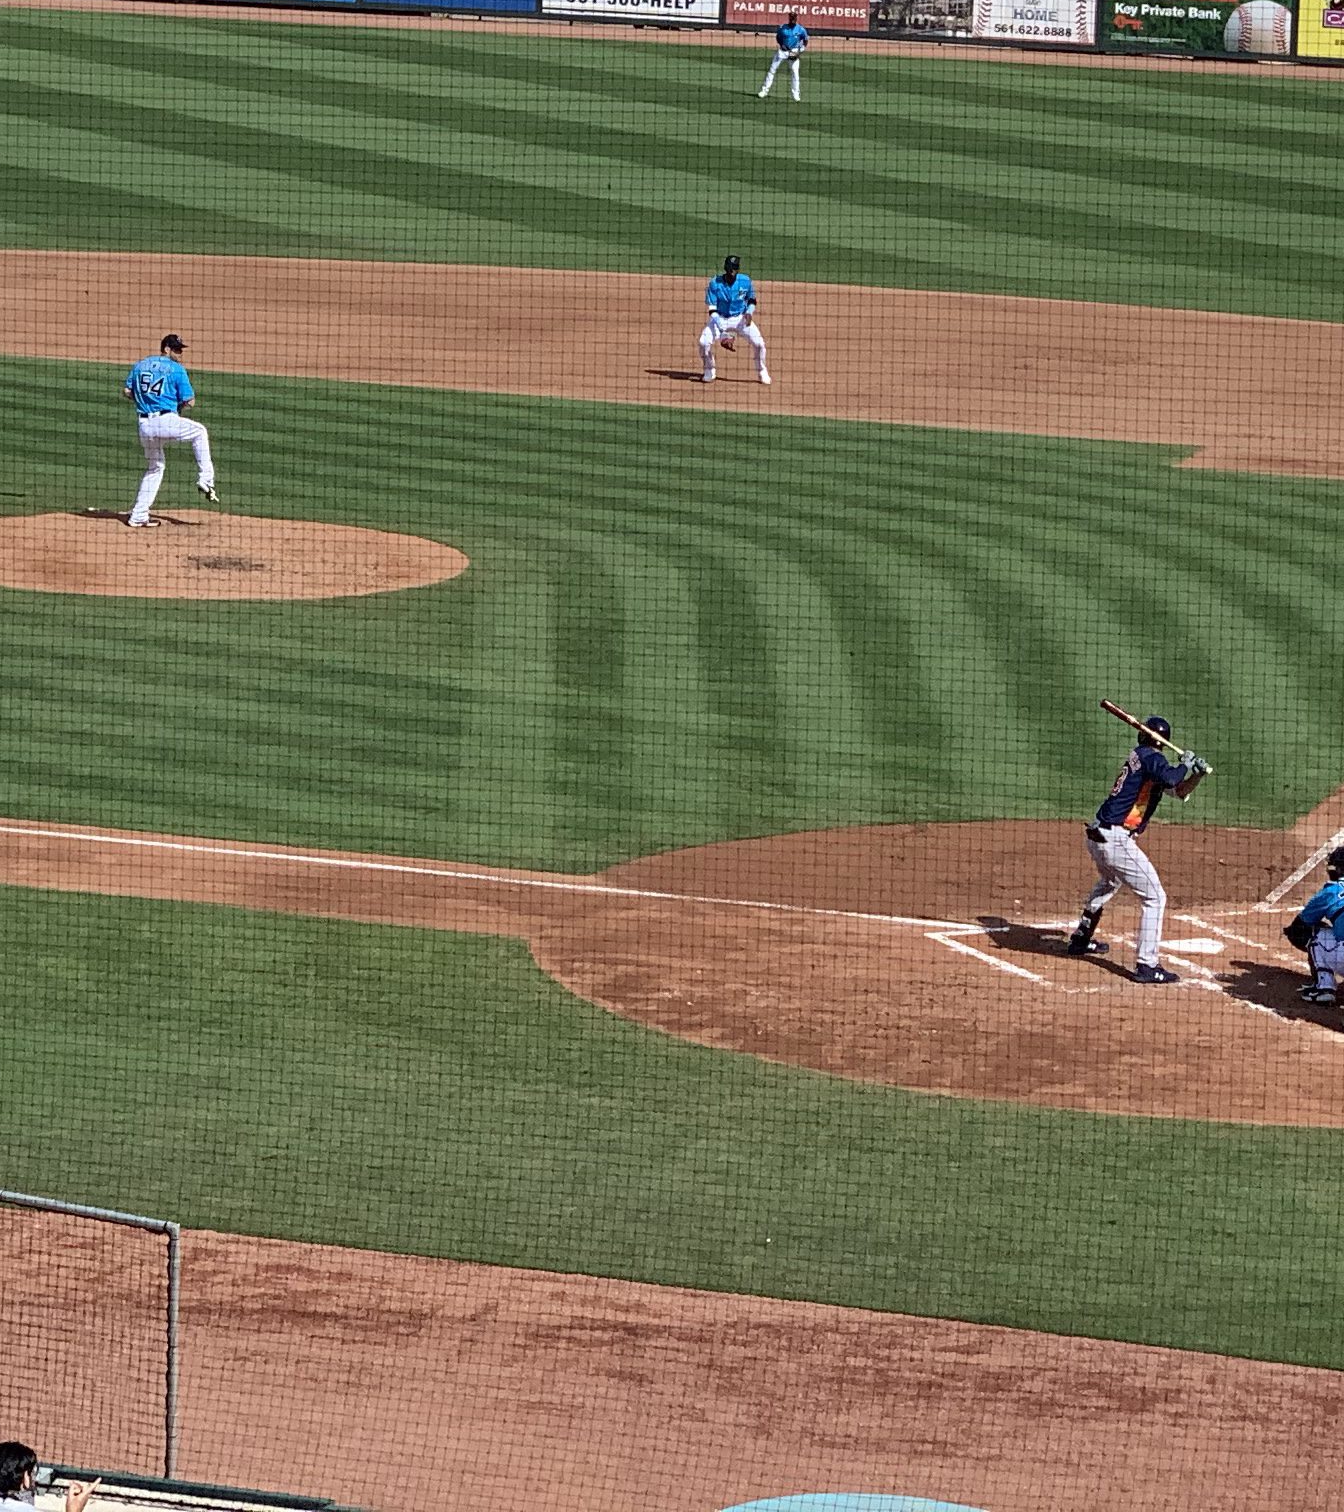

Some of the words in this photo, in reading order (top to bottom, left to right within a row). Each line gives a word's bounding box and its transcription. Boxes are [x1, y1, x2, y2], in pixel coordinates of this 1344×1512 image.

[733, 1, 764, 12] PALM
[768, 3, 807, 15] BEACH
[811, 6, 867, 19] GARDENS
[1013, 8, 1059, 23] HOME
[1114, 2, 1138, 17] Key
[1141, 3, 1186, 18] Private
[1188, 7, 1222, 20] Bank
[994, 23, 1072, 38] 561.622.8888
[139, 371, 166, 397] 54
